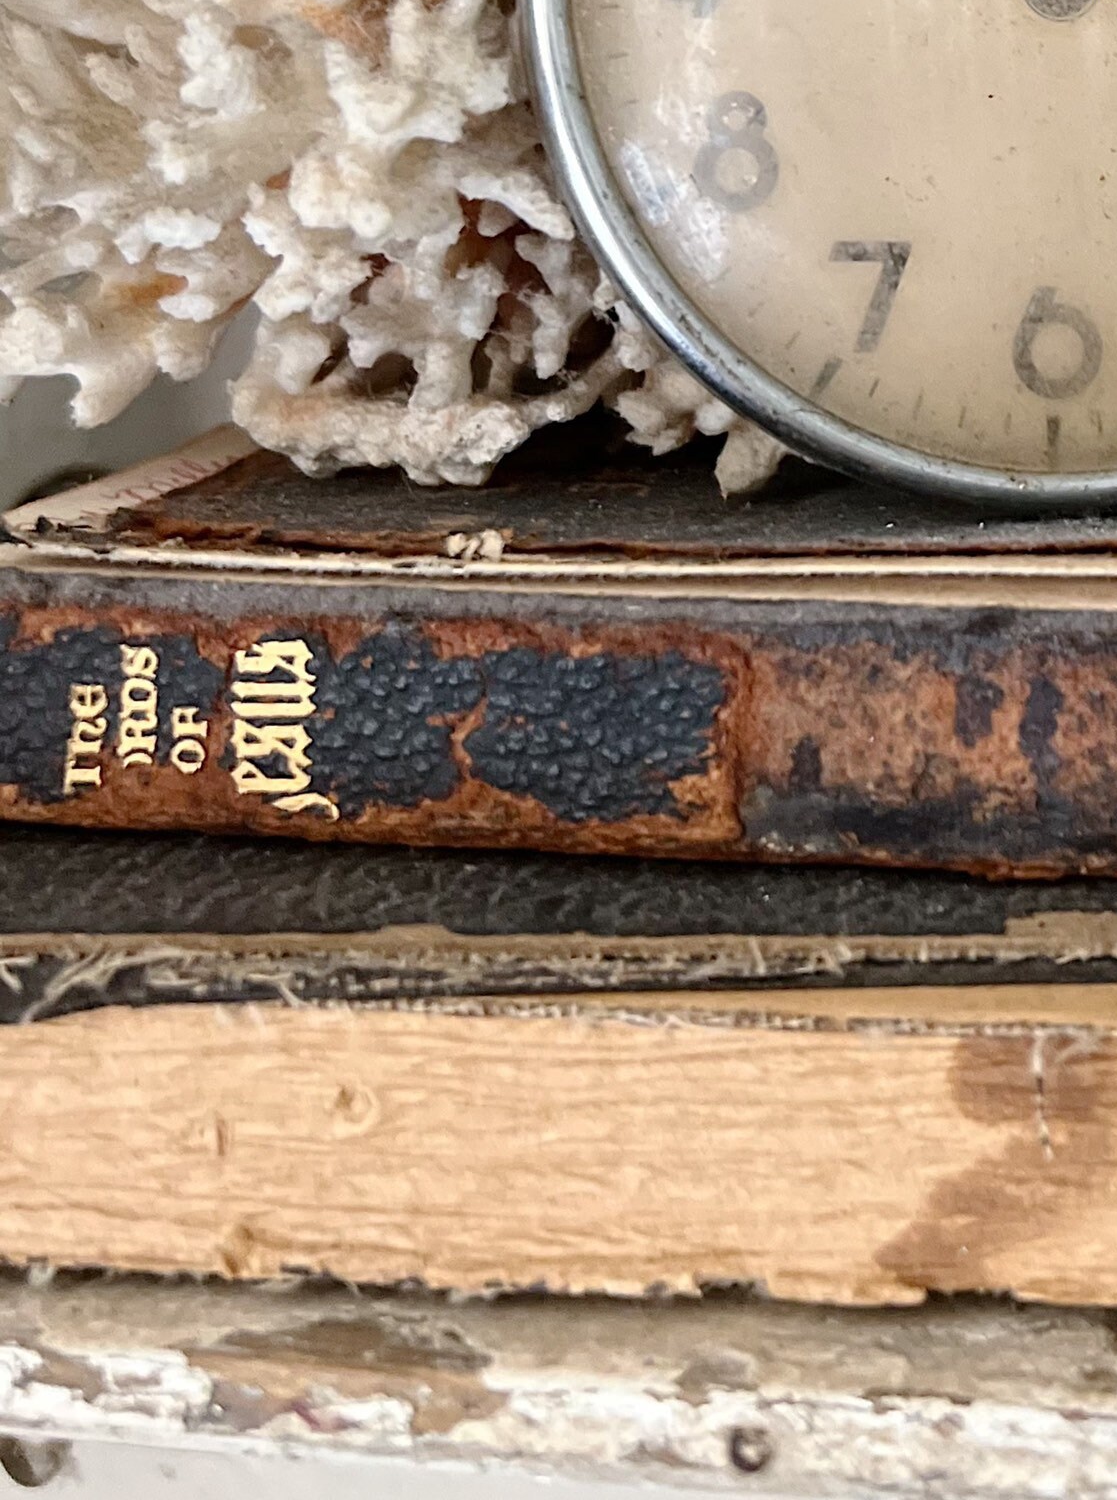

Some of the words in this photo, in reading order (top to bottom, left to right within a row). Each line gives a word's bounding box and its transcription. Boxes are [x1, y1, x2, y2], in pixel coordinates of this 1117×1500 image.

[692, 89, 779, 211] 8
[829, 241, 912, 352] 7
[1012, 286, 1103, 399] 6
[170, 705, 209, 775] OF
